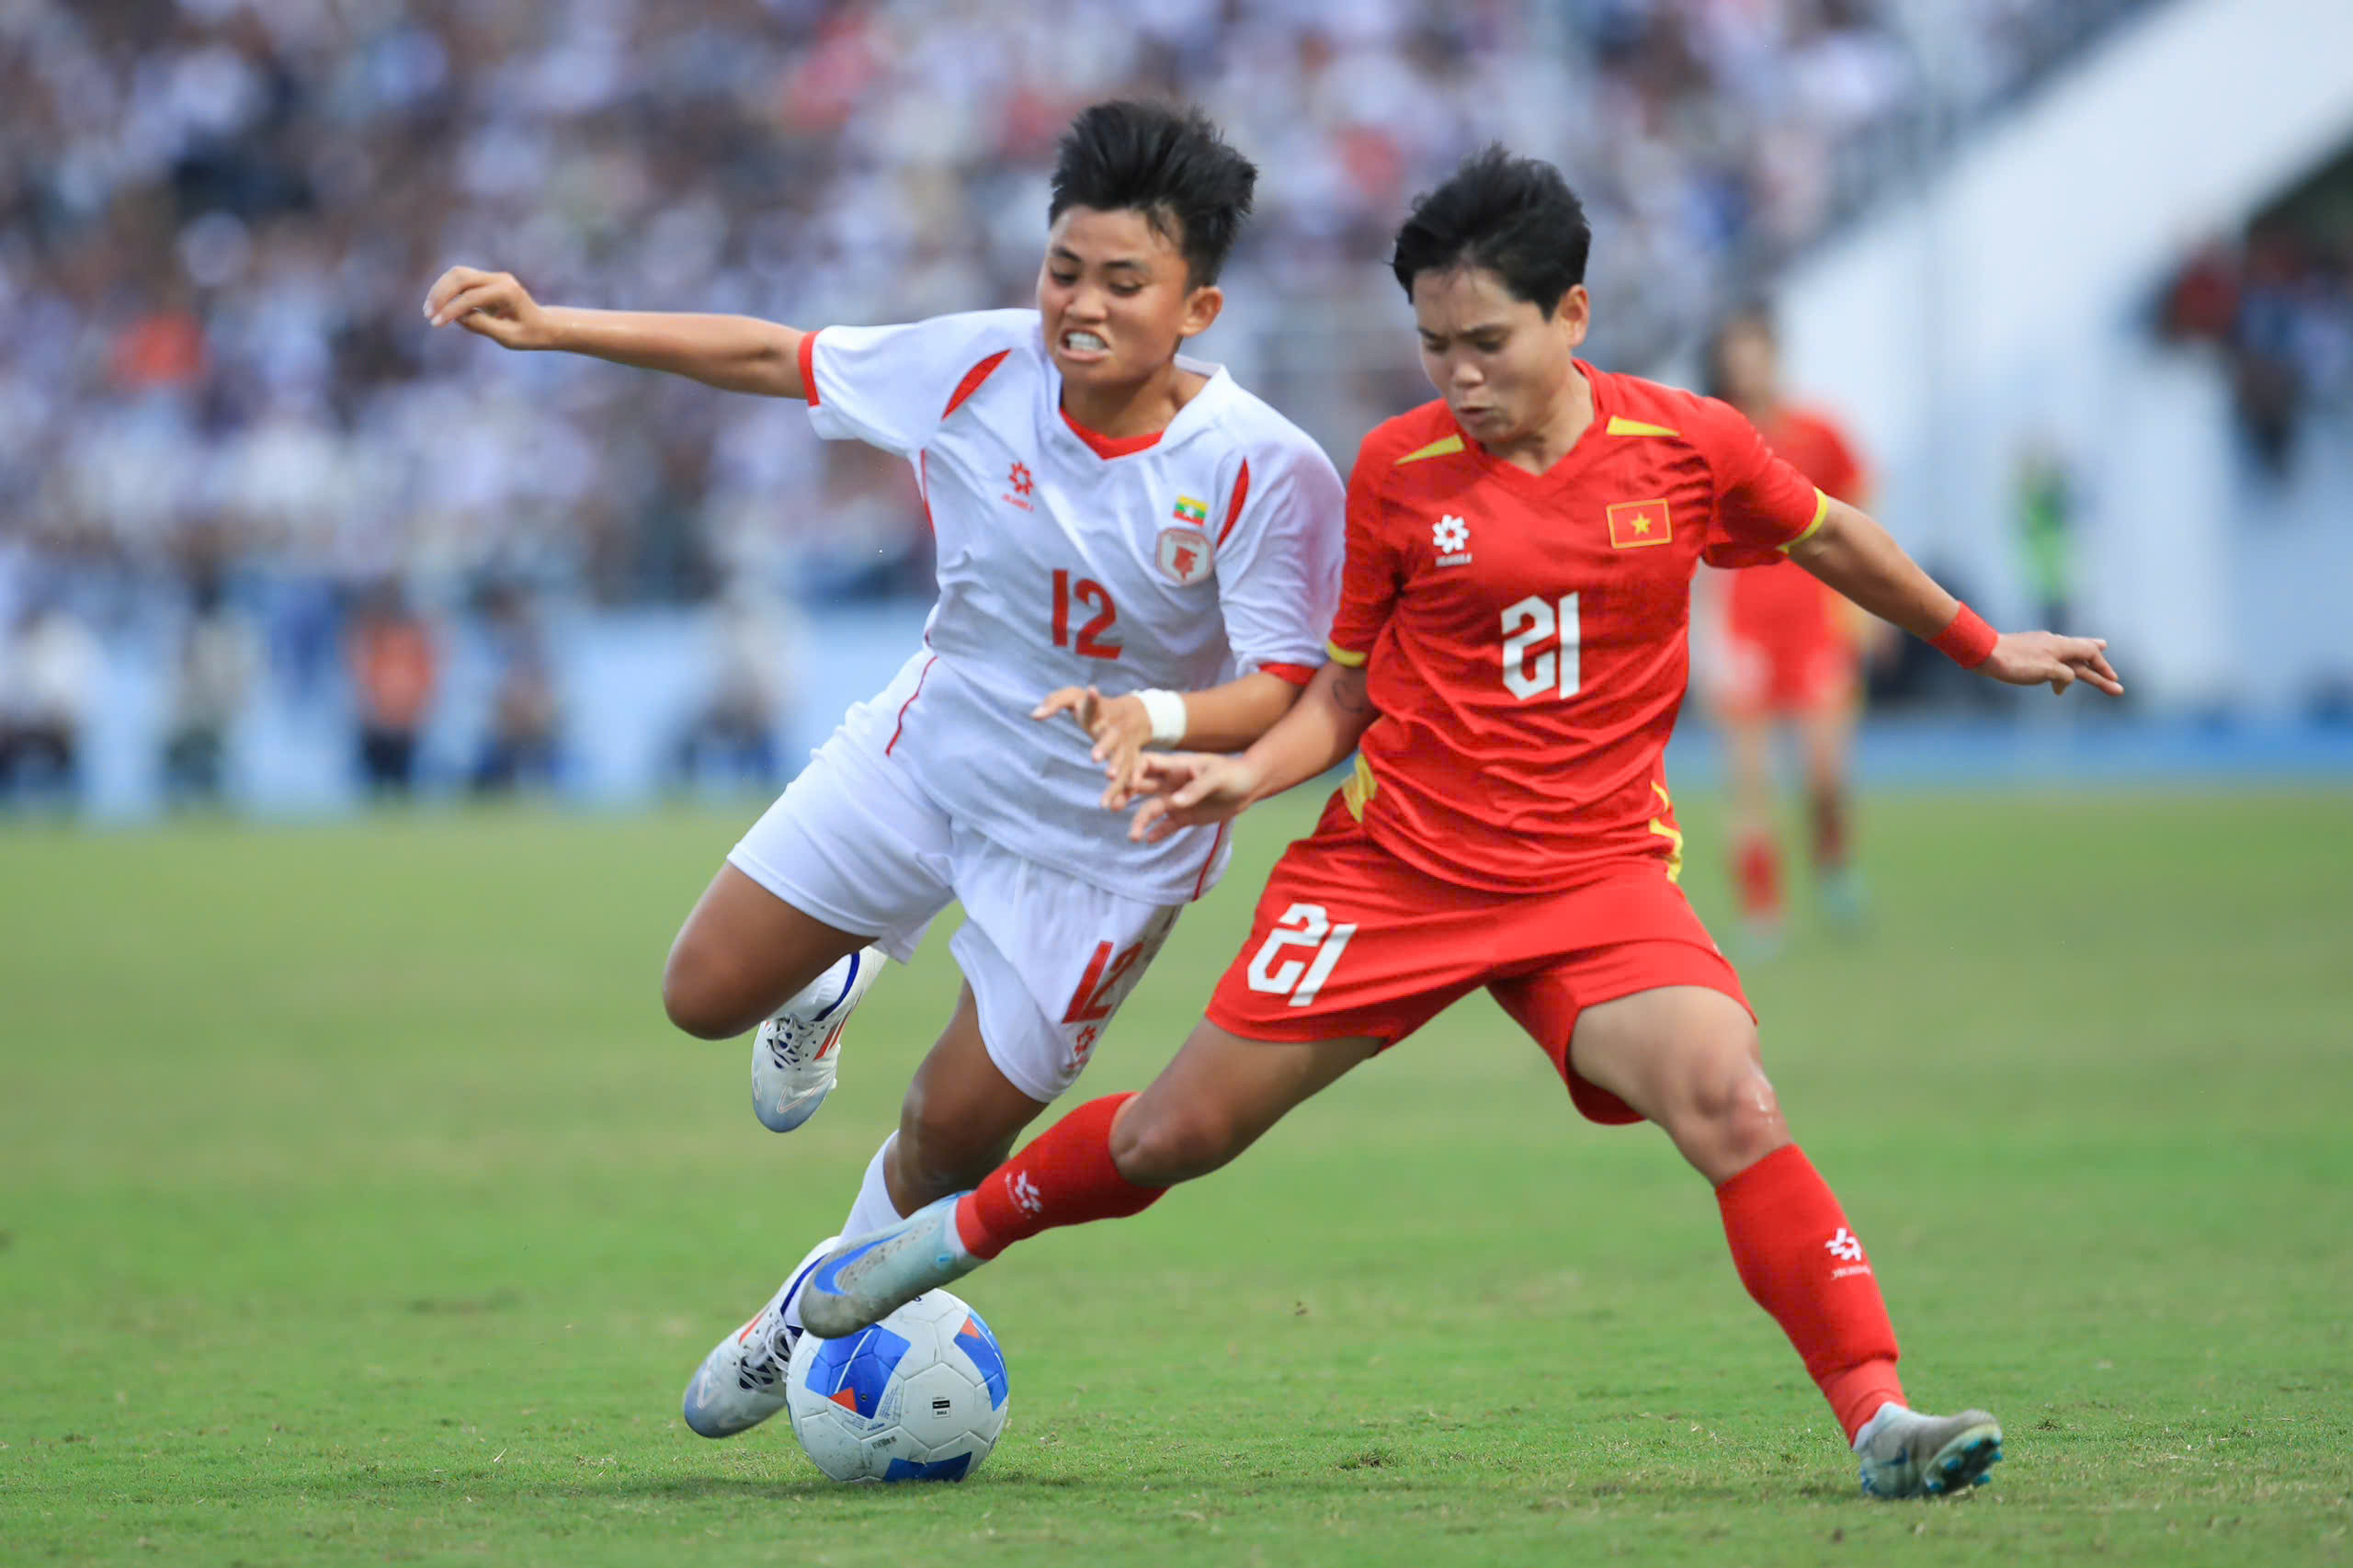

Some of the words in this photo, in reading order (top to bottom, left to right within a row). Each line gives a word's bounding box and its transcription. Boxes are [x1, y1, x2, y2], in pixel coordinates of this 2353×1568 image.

[1051, 569, 1122, 660] 12
[1501, 591, 1580, 700] 21
[1062, 941, 1144, 1024] 12
[1247, 903, 1358, 1006] 21
